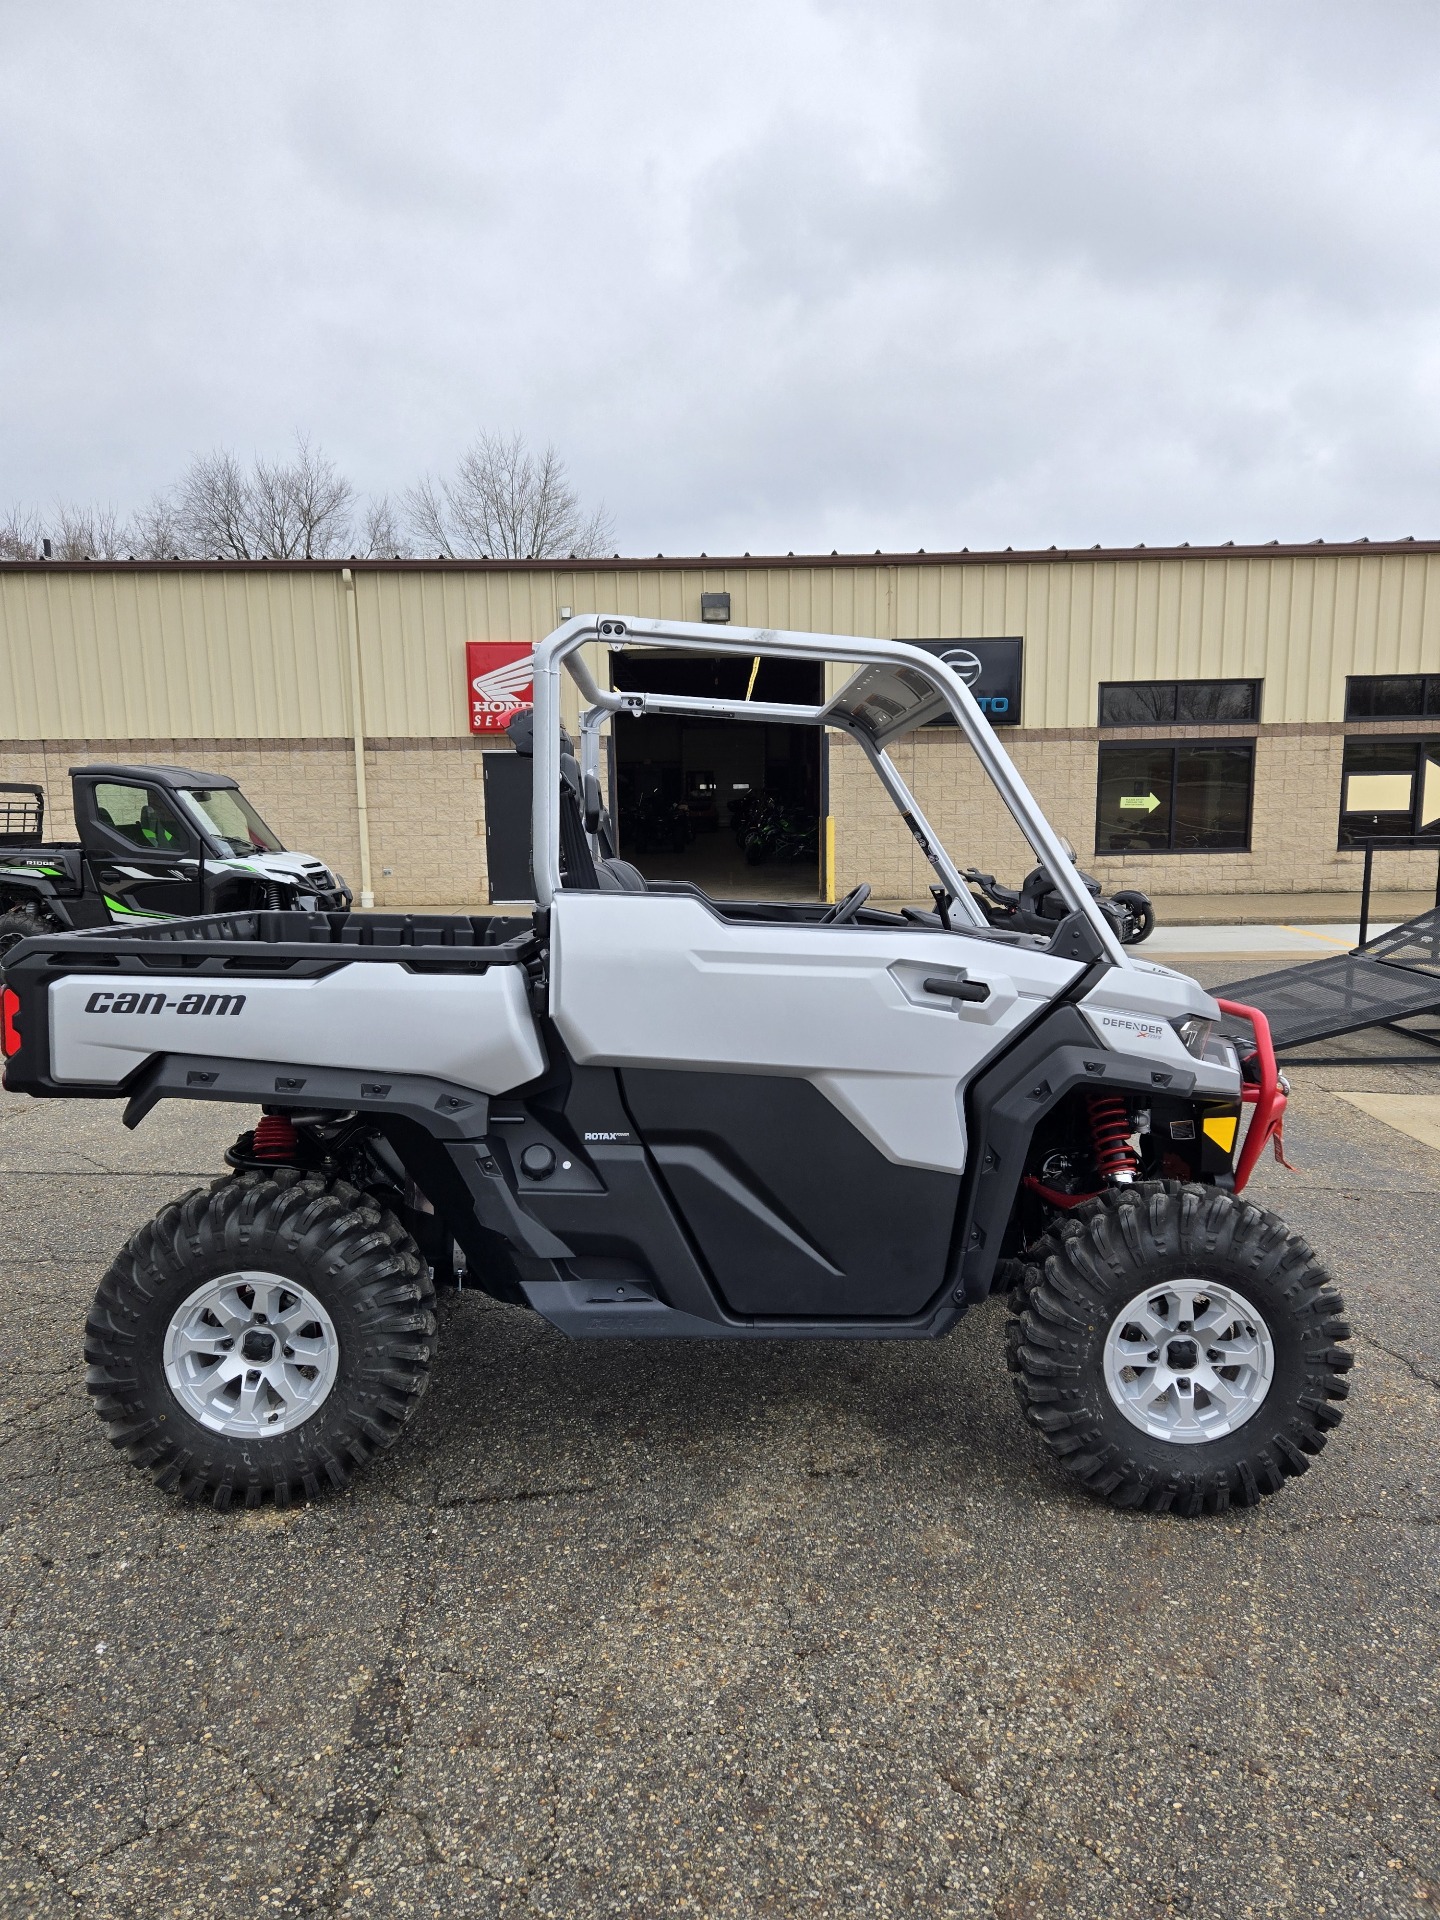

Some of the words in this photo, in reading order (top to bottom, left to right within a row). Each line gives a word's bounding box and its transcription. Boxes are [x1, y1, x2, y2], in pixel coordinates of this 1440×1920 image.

[976, 697, 1009, 713] TO
[1102, 1017, 1163, 1035] DEFENDER
[584, 1132, 617, 1141] ROTAX
